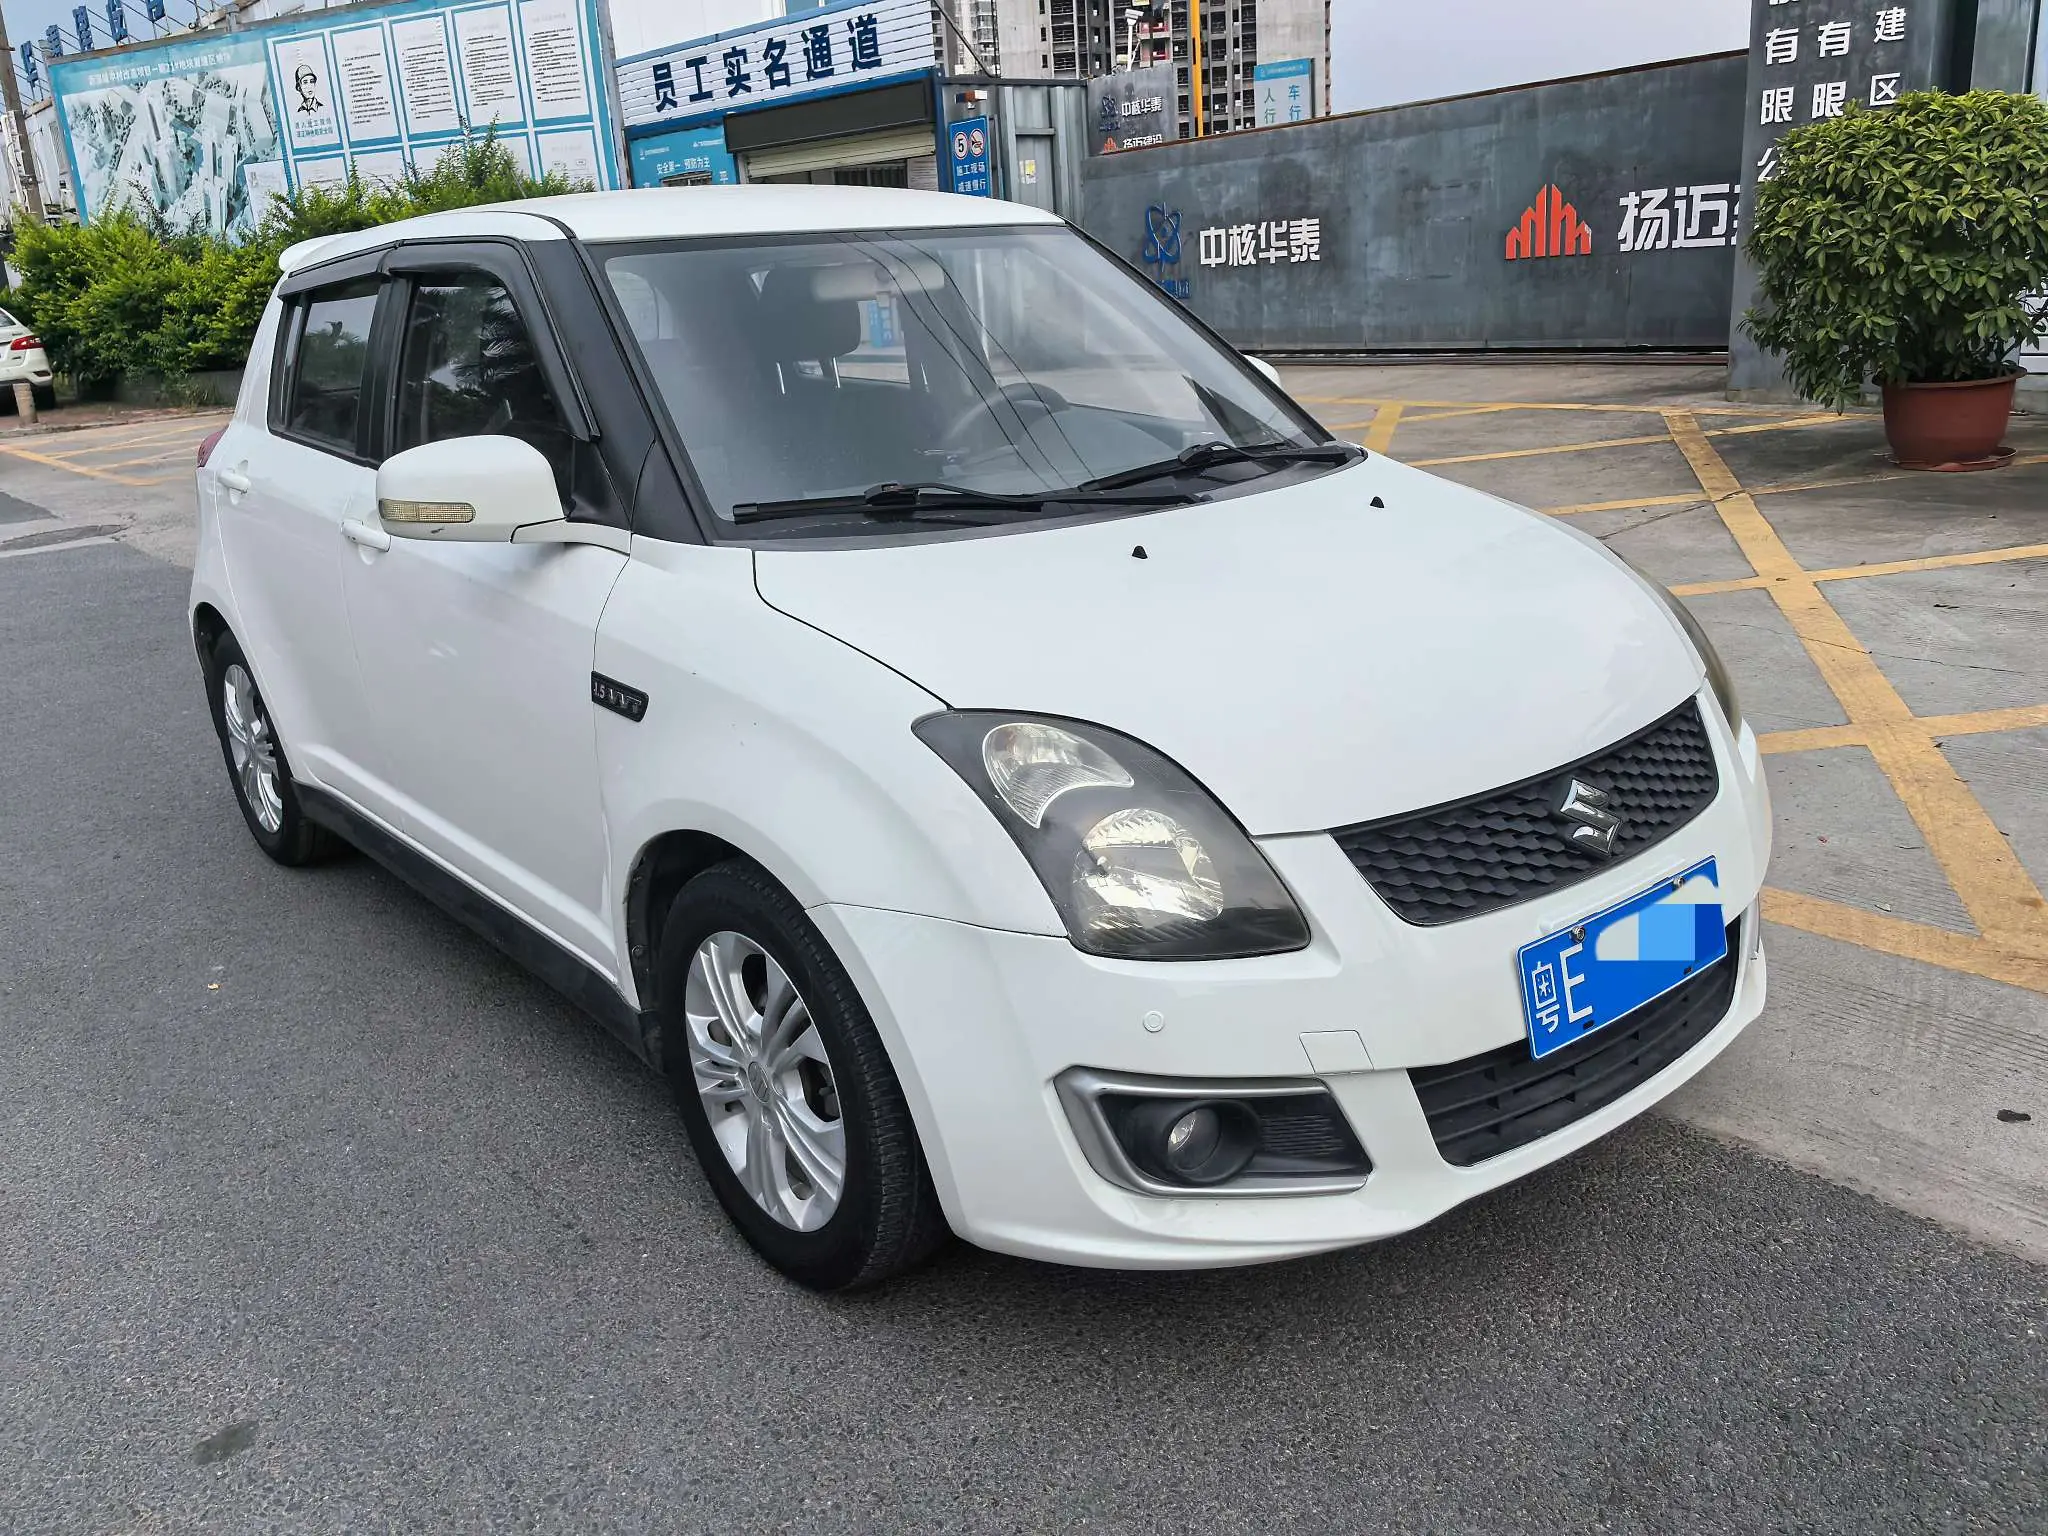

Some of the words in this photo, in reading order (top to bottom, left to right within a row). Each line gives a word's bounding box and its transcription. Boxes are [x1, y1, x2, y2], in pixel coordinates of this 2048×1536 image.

[652, 13, 882, 113] 员工实名通道
[1811, 21, 1851, 119] 有限
[1869, 6, 1906, 107] 建区
[1121, 96, 1163, 117] 中核华泰
[1264, 87, 1276, 124] 人行
[1288, 84, 1301, 121] 车行
[1757, 0, 1799, 182] 有限公
[656, 161, 680, 174] 安全第一
[956, 161, 985, 176] 施工现场
[958, 138, 964, 153] 5
[1199, 217, 1321, 268] 中核华泰
[1617, 183, 1741, 252] 扬迈
[1531, 943, 1594, 1033] 粤E
